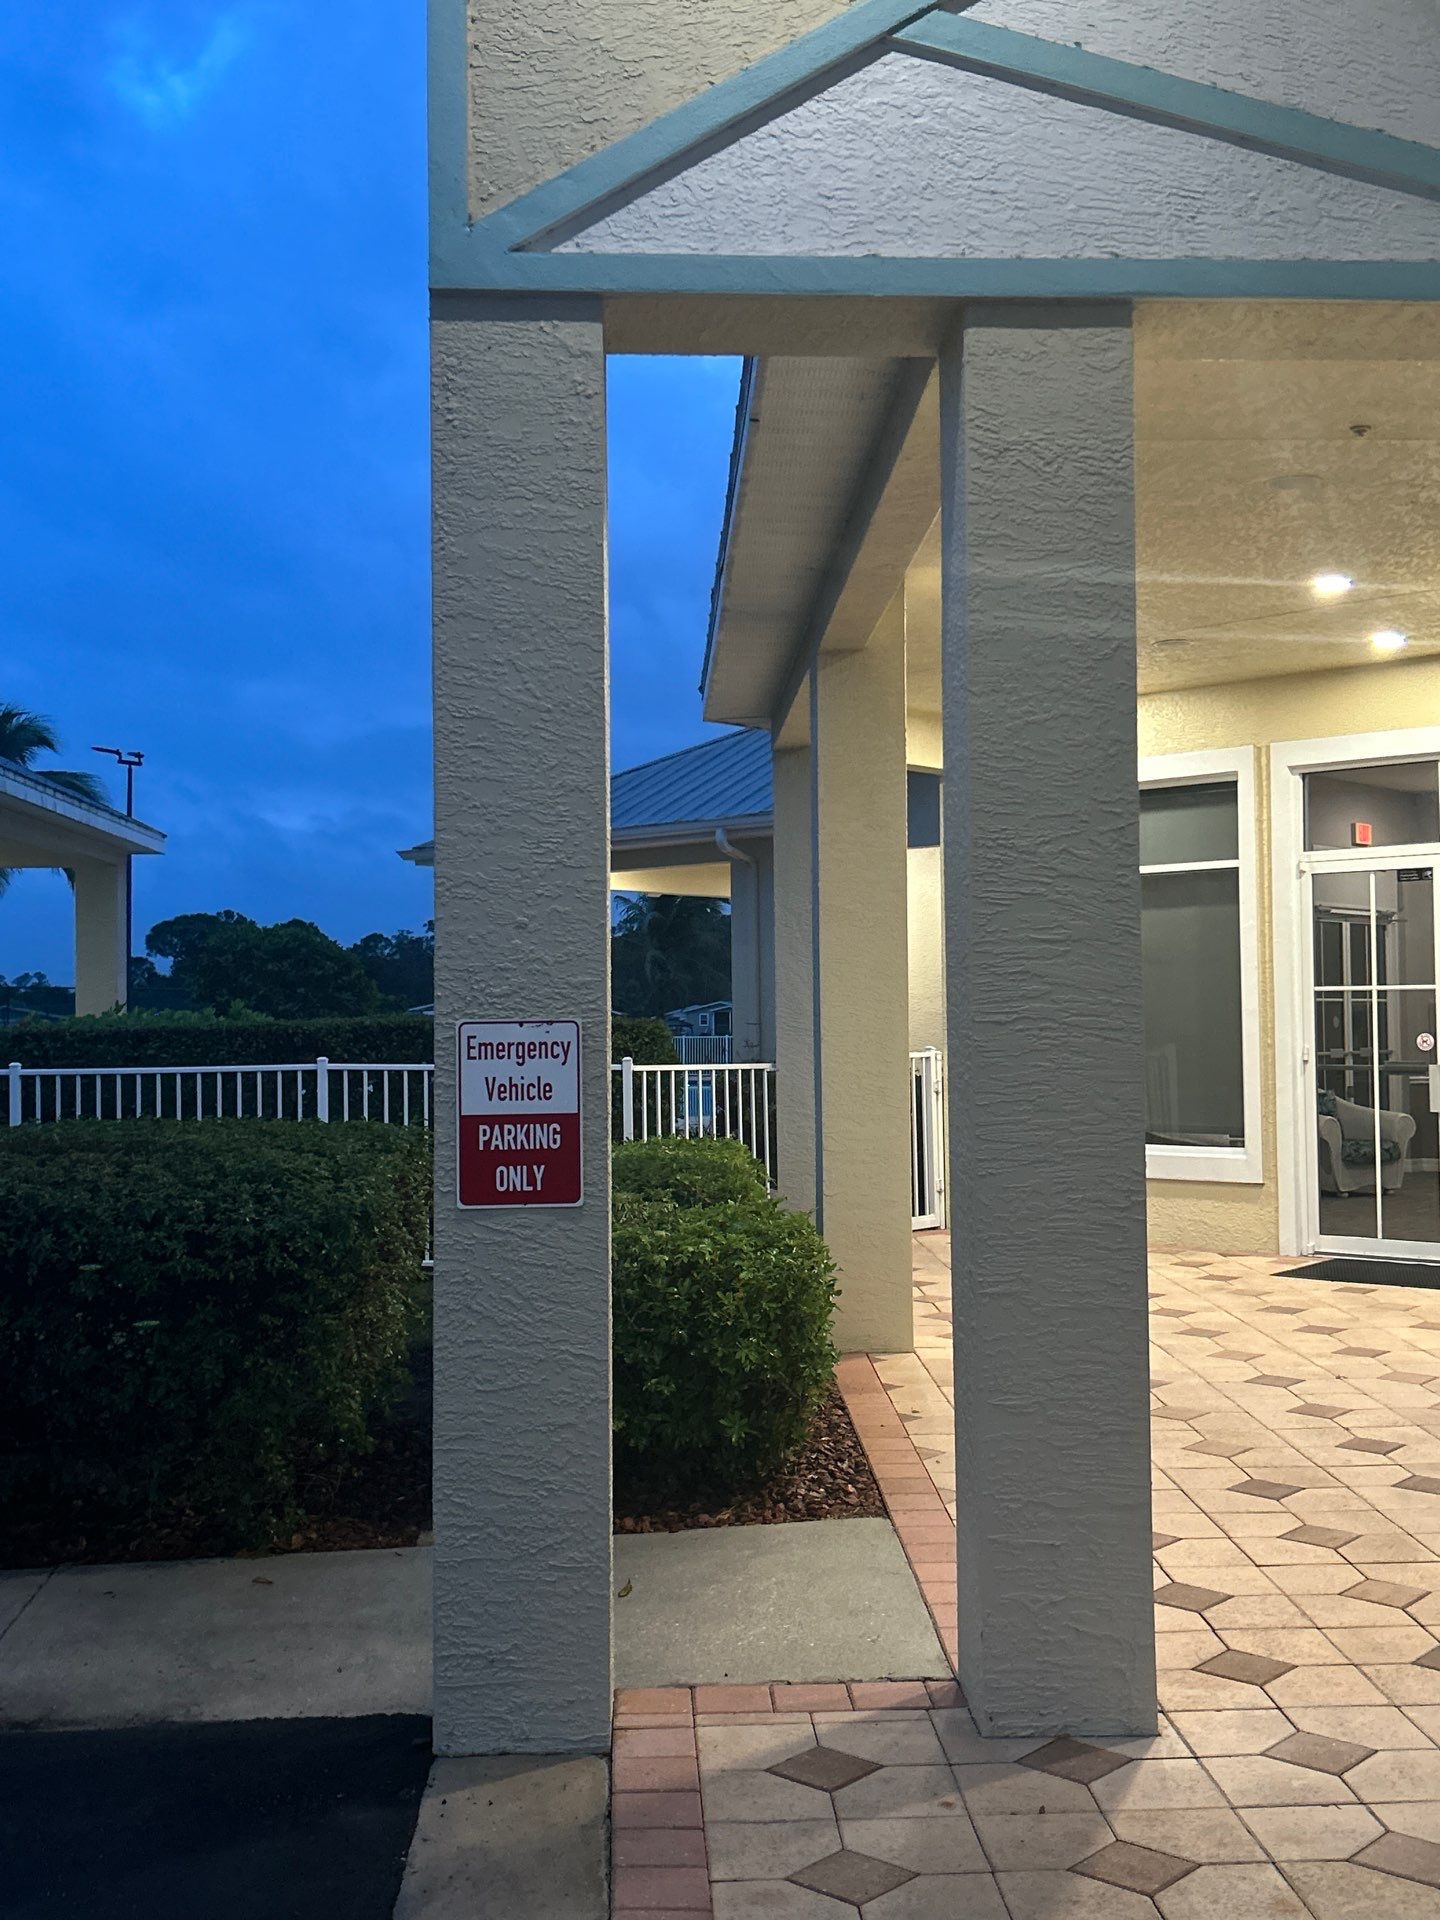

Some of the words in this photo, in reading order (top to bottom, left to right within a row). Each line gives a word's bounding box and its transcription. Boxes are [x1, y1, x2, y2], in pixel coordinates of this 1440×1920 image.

[466, 1035, 571, 1067] Emergency
[484, 1076, 553, 1102] Vehicle
[478, 1123, 561, 1151] PARKING
[495, 1165, 545, 1192] ONLY
